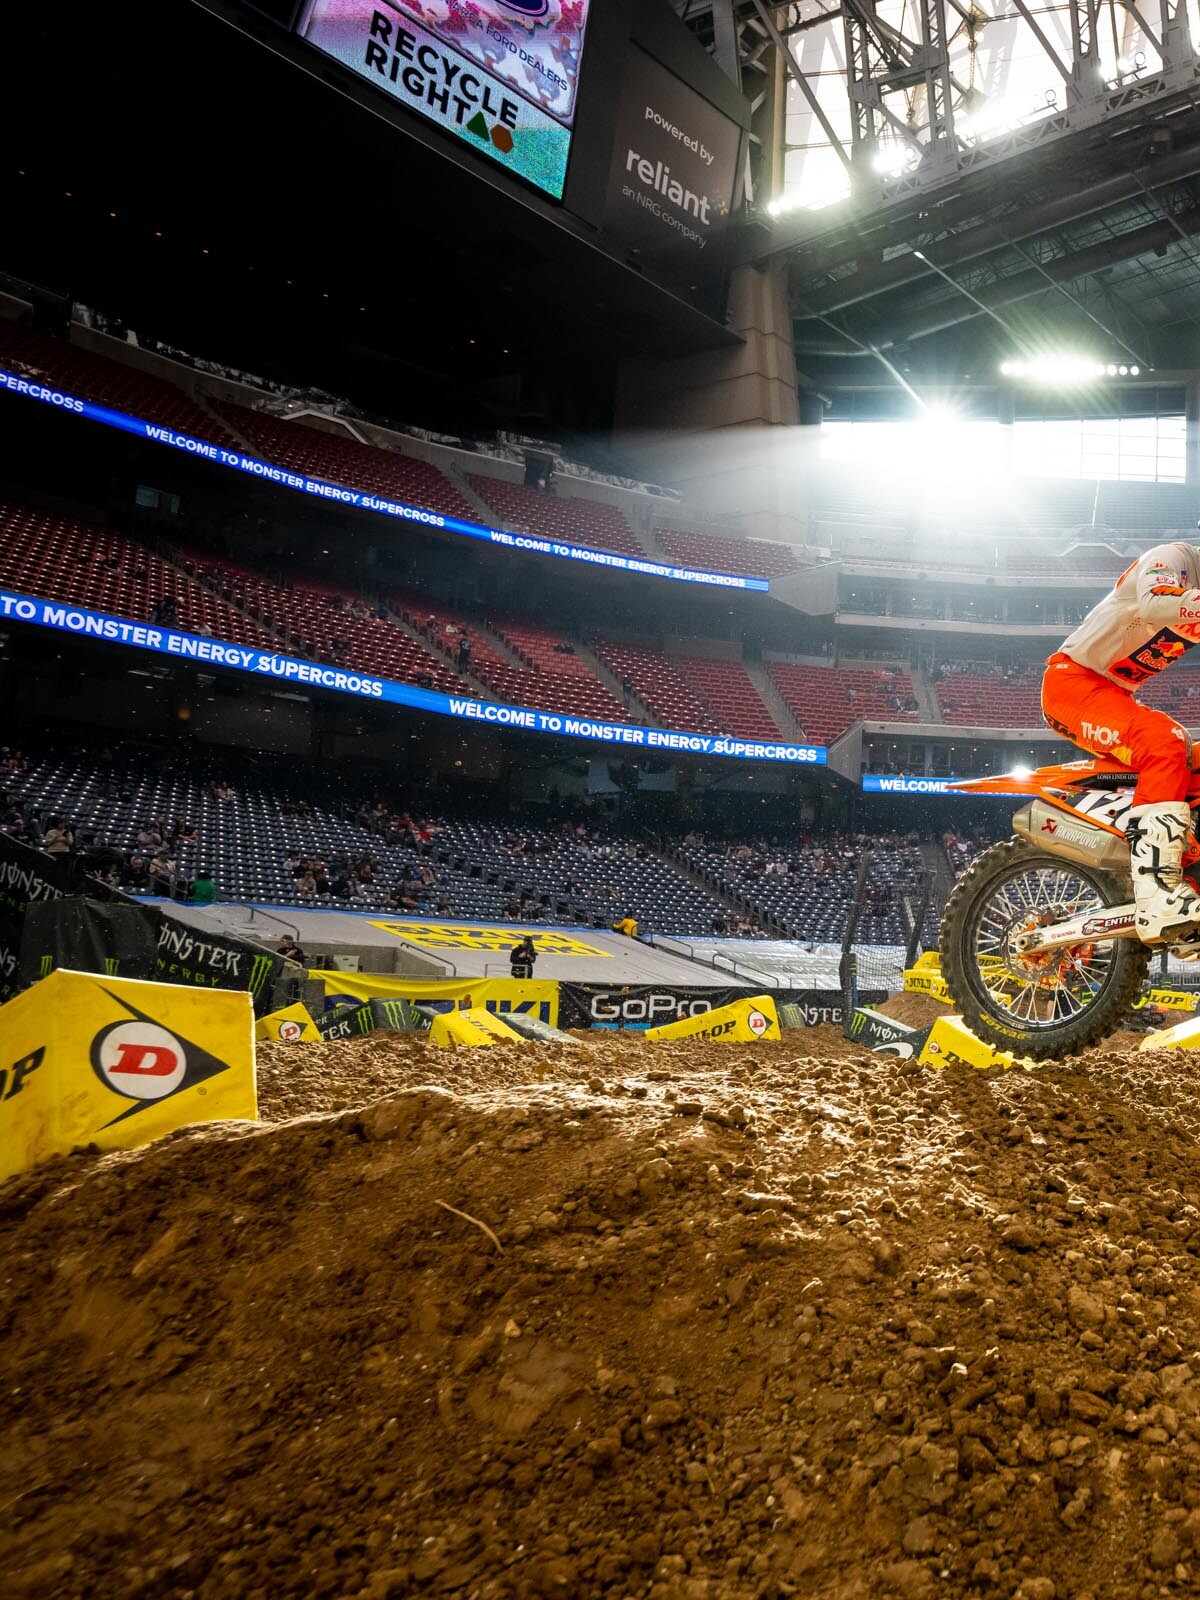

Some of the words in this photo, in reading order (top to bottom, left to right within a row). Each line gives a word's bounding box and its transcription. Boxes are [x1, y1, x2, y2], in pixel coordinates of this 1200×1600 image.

[365, 39, 471, 125] RIGHT
[370, 10, 519, 129] RECYCLE
[486, 26, 518, 54] FORD
[519, 47, 568, 91] DEALERS
[644, 106, 699, 153] powered
[700, 144, 714, 166] by
[622, 185, 635, 199] an
[637, 192, 661, 217] NRG
[662, 212, 707, 249] company
[626, 149, 711, 226] reliant
[145, 424, 218, 459] WELCOME
[220, 450, 239, 466] TO
[241, 457, 304, 489] MONSTER
[306, 479, 360, 505] ENERGY
[361, 495, 445, 527] SUPERCROSS
[490, 530, 551, 553] WELCOME
[553, 543, 570, 556] TO
[571, 548, 627, 569] MONSTER
[628, 560, 673, 579] ENERGY
[673, 568, 746, 588] SUPERCROSS
[1, 596, 36, 619] TO
[43, 608, 162, 648] MONSTER
[168, 633, 255, 669] ENERGY
[258, 655, 383, 697] SUPERCROSS
[449, 698, 537, 729] WELCOME
[539, 715, 562, 731] TO
[565, 720, 644, 744] MONSTER
[648, 733, 711, 752] ENERGY
[714, 740, 817, 762] SUPERCROSS
[879, 779, 949, 793] WELCOME
[384, 924, 572, 943] SUZUKI
[590, 994, 712, 1020] GoPro
